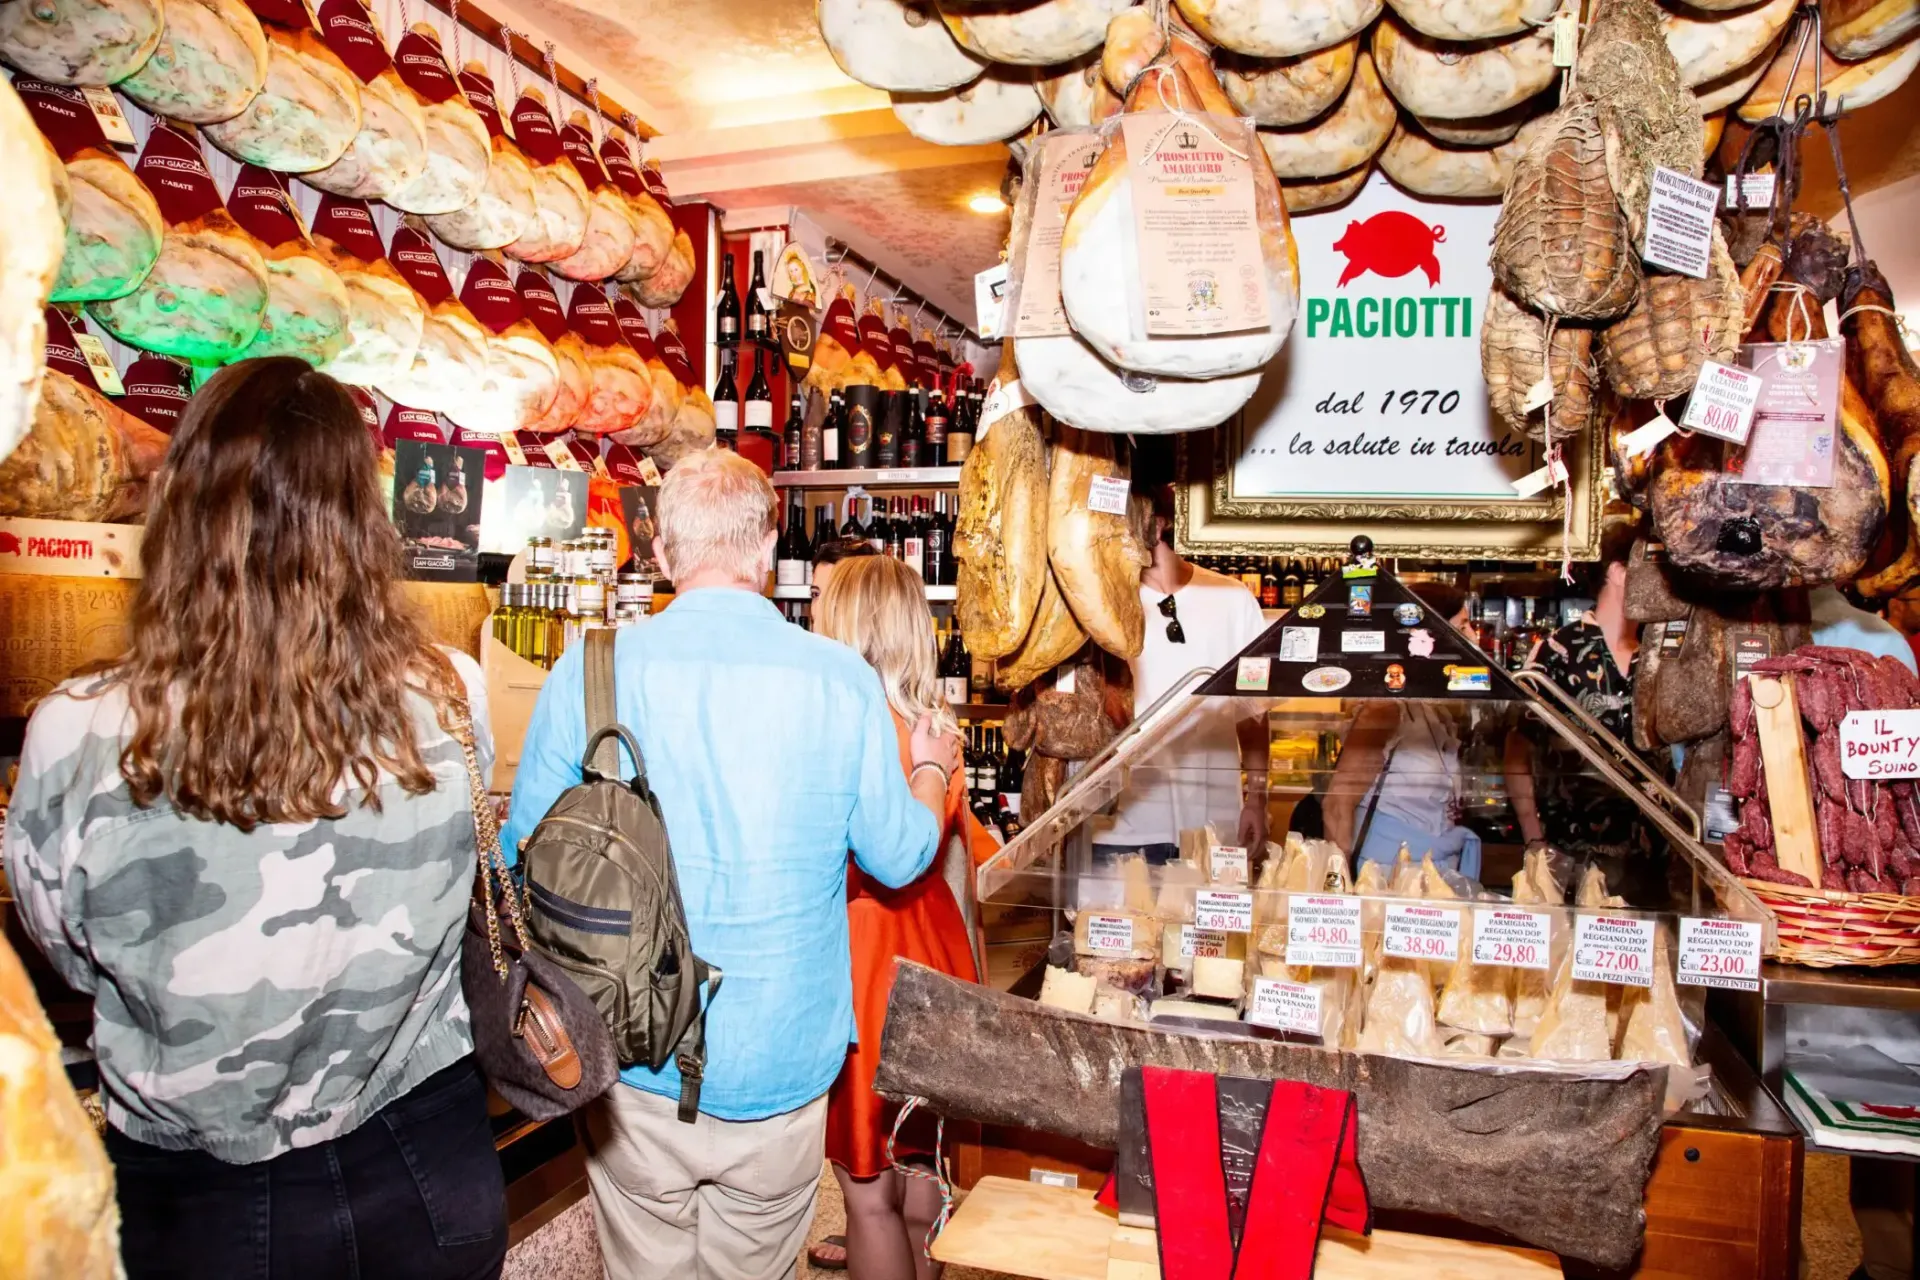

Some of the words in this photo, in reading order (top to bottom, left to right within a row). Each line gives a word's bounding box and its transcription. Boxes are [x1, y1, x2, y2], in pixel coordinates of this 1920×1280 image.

[348, 36, 374, 46] L'ABATE
[21, 83, 42, 91] SAN
[38, 101, 77, 118] L'ABATE
[147, 158, 165, 166] SAN
[1155, 152, 1225, 163] PROSCIUTTO
[1162, 163, 1223, 174] AMARCORD
[161, 178, 194, 191] L'ABATE
[1656, 170, 1689, 191] PROSCIUTTO
[1695, 185, 1716, 202] PECORA
[348, 227, 374, 237] L'ABATE
[1307, 297, 1473, 338] PACIOTTI
[1725, 370, 1748, 382] PACIOTTI
[1710, 374, 1749, 392] CULATELLO
[131, 386, 149, 394] SAN
[1700, 384, 1710, 392] DI
[1709, 387, 1738, 402] ZIBELLO
[1736, 395, 1753, 406] DOP
[1315, 391, 1365, 414] dal
[1379, 389, 1461, 415] 1970
[145, 406, 178, 418] L'ABATE
[1703, 405, 1739, 433] 80,00
[1289, 432, 1315, 456] la
[1323, 432, 1401, 456] salute
[1411, 436, 1437, 456] in
[1445, 432, 1526, 457] tavola
[27, 537, 93, 560] PACIOTTI
[1874, 719, 1893, 735] IL
[1847, 737, 1920, 757] BOUNTY
[1290, 906, 1322, 915] PARMIGIANO
[1322, 907, 1348, 916] REGGIANO
[1348, 909, 1360, 917] DOP
[1414, 908, 1443, 918] PACIOTTI
[1503, 912, 1533, 921] PACIOTTI
[1210, 914, 1243, 930] 69,50
[1322, 917, 1356, 926] MONTAGNA
[1387, 914, 1420, 926] PARMIGIANO
[1419, 918, 1446, 929] REGGIANO
[1446, 920, 1459, 929] DOP
[1488, 918, 1538, 929] PARMIGIANO
[1606, 918, 1637, 928] PACIOTTI
[1711, 921, 1742, 930] PACIOTTI
[1308, 926, 1348, 944] 49,80
[1484, 927, 1524, 936] REGGIANO
[1524, 929, 1542, 937] DOP
[1588, 923, 1644, 936] PARMIGIANO
[1692, 927, 1749, 938] PARMIGIANO
[1506, 936, 1546, 945] MONTAGNA
[1582, 932, 1627, 943] REGGIANO
[1628, 936, 1648, 945] DOP
[1687, 936, 1733, 946] REGGIANO
[1734, 940, 1754, 948] DOP
[1403, 935, 1445, 956] 38,90
[1614, 944, 1647, 954] COLLINA
[1719, 947, 1753, 956] PIANURA
[1291, 950, 1308, 962] SOLO
[1334, 952, 1357, 964] INTERI
[1493, 942, 1537, 963] 29,80
[1594, 949, 1639, 971] 27,00
[1700, 954, 1745, 975] 23,00
[1574, 969, 1595, 978] SOLO
[1595, 971, 1602, 980] A
[1602, 972, 1624, 982] PEZZI
[1624, 974, 1650, 985] INTERI
[1680, 974, 1701, 983] SOLO
[1702, 976, 1708, 985] A
[1708, 977, 1729, 987] PEZZI
[1730, 979, 1757, 990] INTERI
[1260, 987, 1280, 996] ARPA
[1290, 992, 1316, 1001] BRADO
[1282, 998, 1317, 1010] VENANZO
[1289, 1007, 1317, 1022] 15,00
